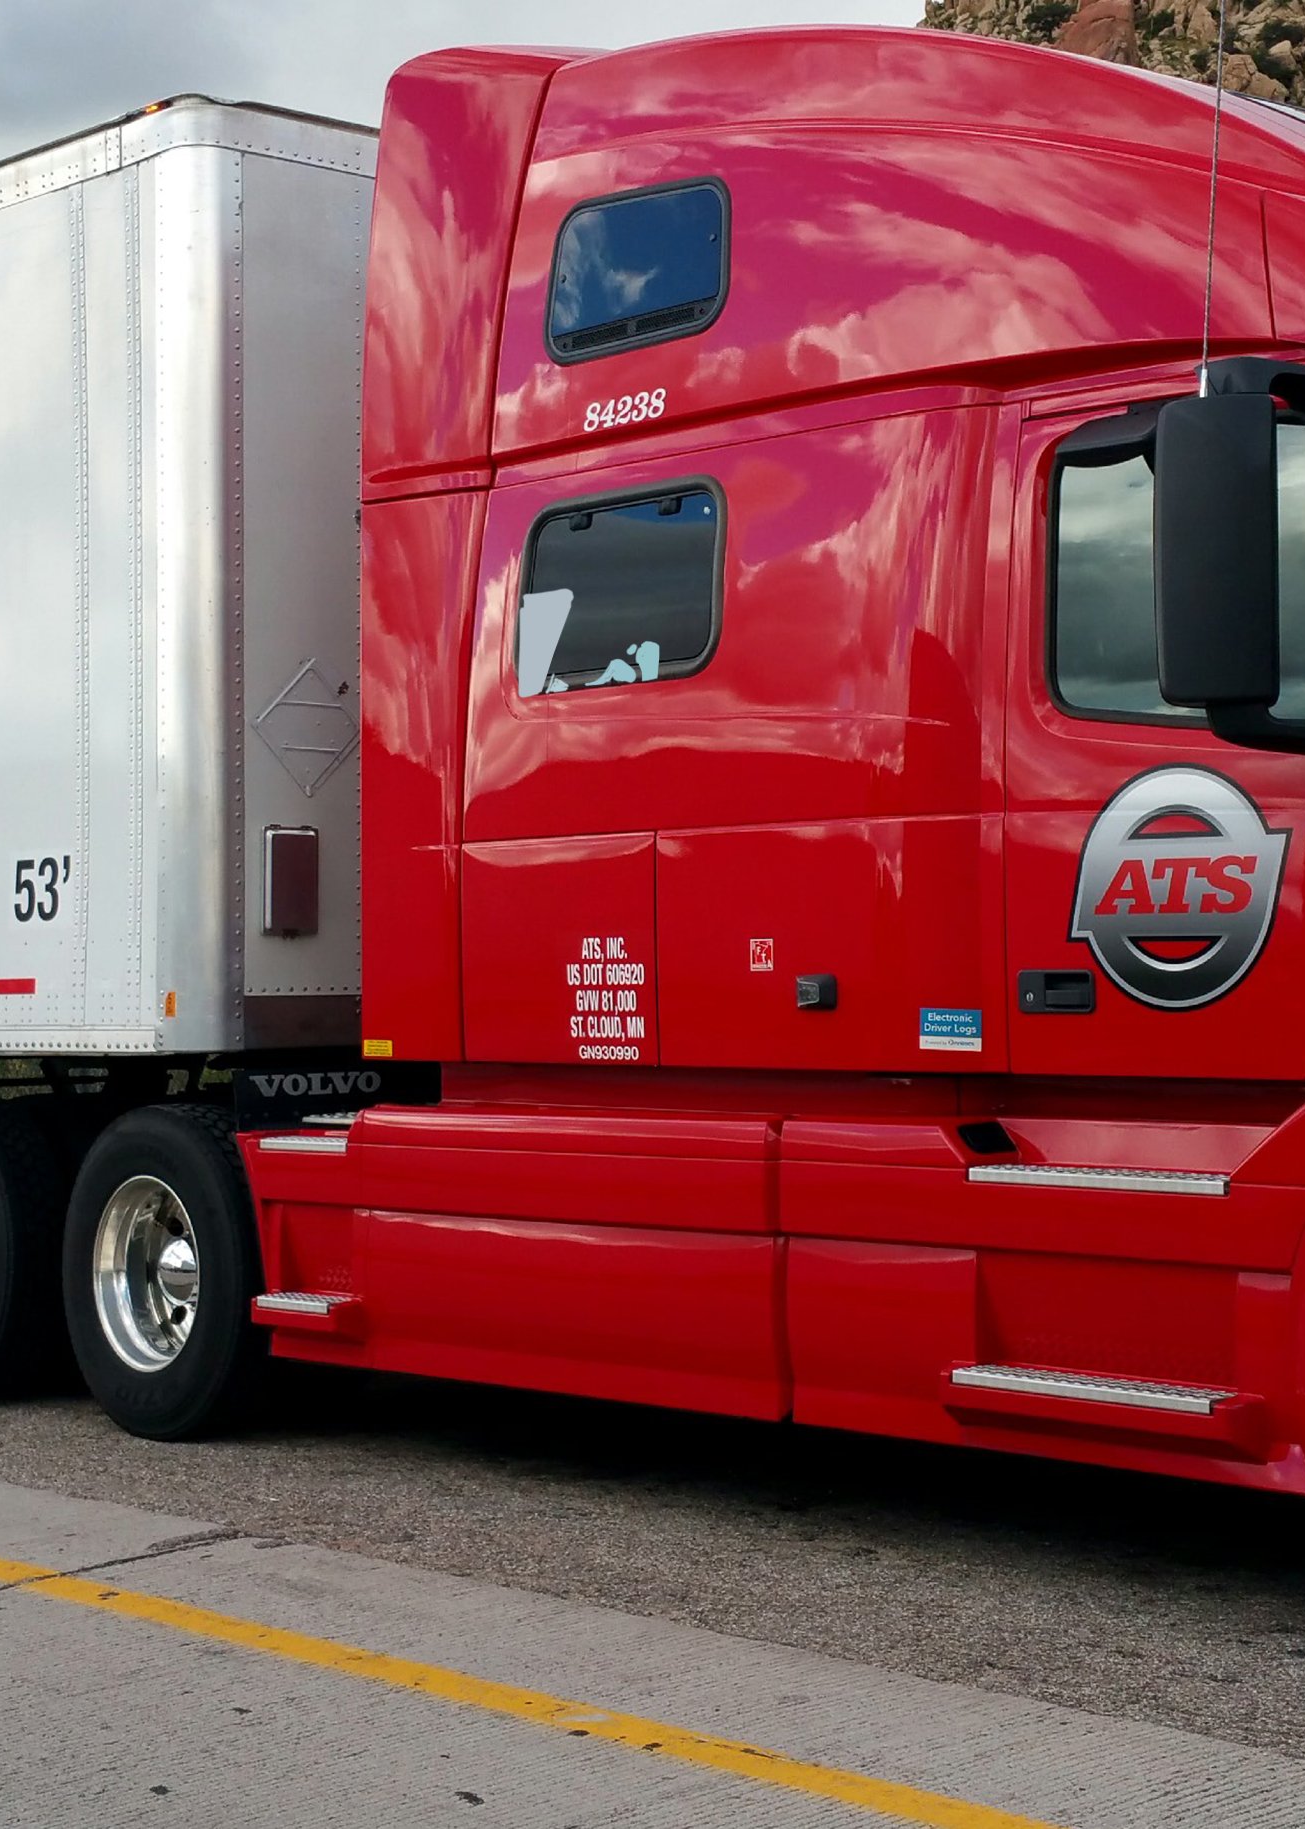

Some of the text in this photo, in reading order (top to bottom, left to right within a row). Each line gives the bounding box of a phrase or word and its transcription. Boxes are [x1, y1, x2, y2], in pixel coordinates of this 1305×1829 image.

[583, 387, 667, 433] 84238
[1094, 855, 1258, 916] ATS
[581, 936, 628, 963] ATS, INC.
[566, 963, 645, 986] US DOT 606920
[576, 989, 637, 1016] GVW 81,000
[570, 1015, 645, 1043] ST. CLOUD, MN
[924, 1022, 977, 1036] Driver Logs
[927, 1012, 973, 1023] Electronic
[578, 1044, 640, 1061] GN930990
[248, 1071, 382, 1098] VOLVO
